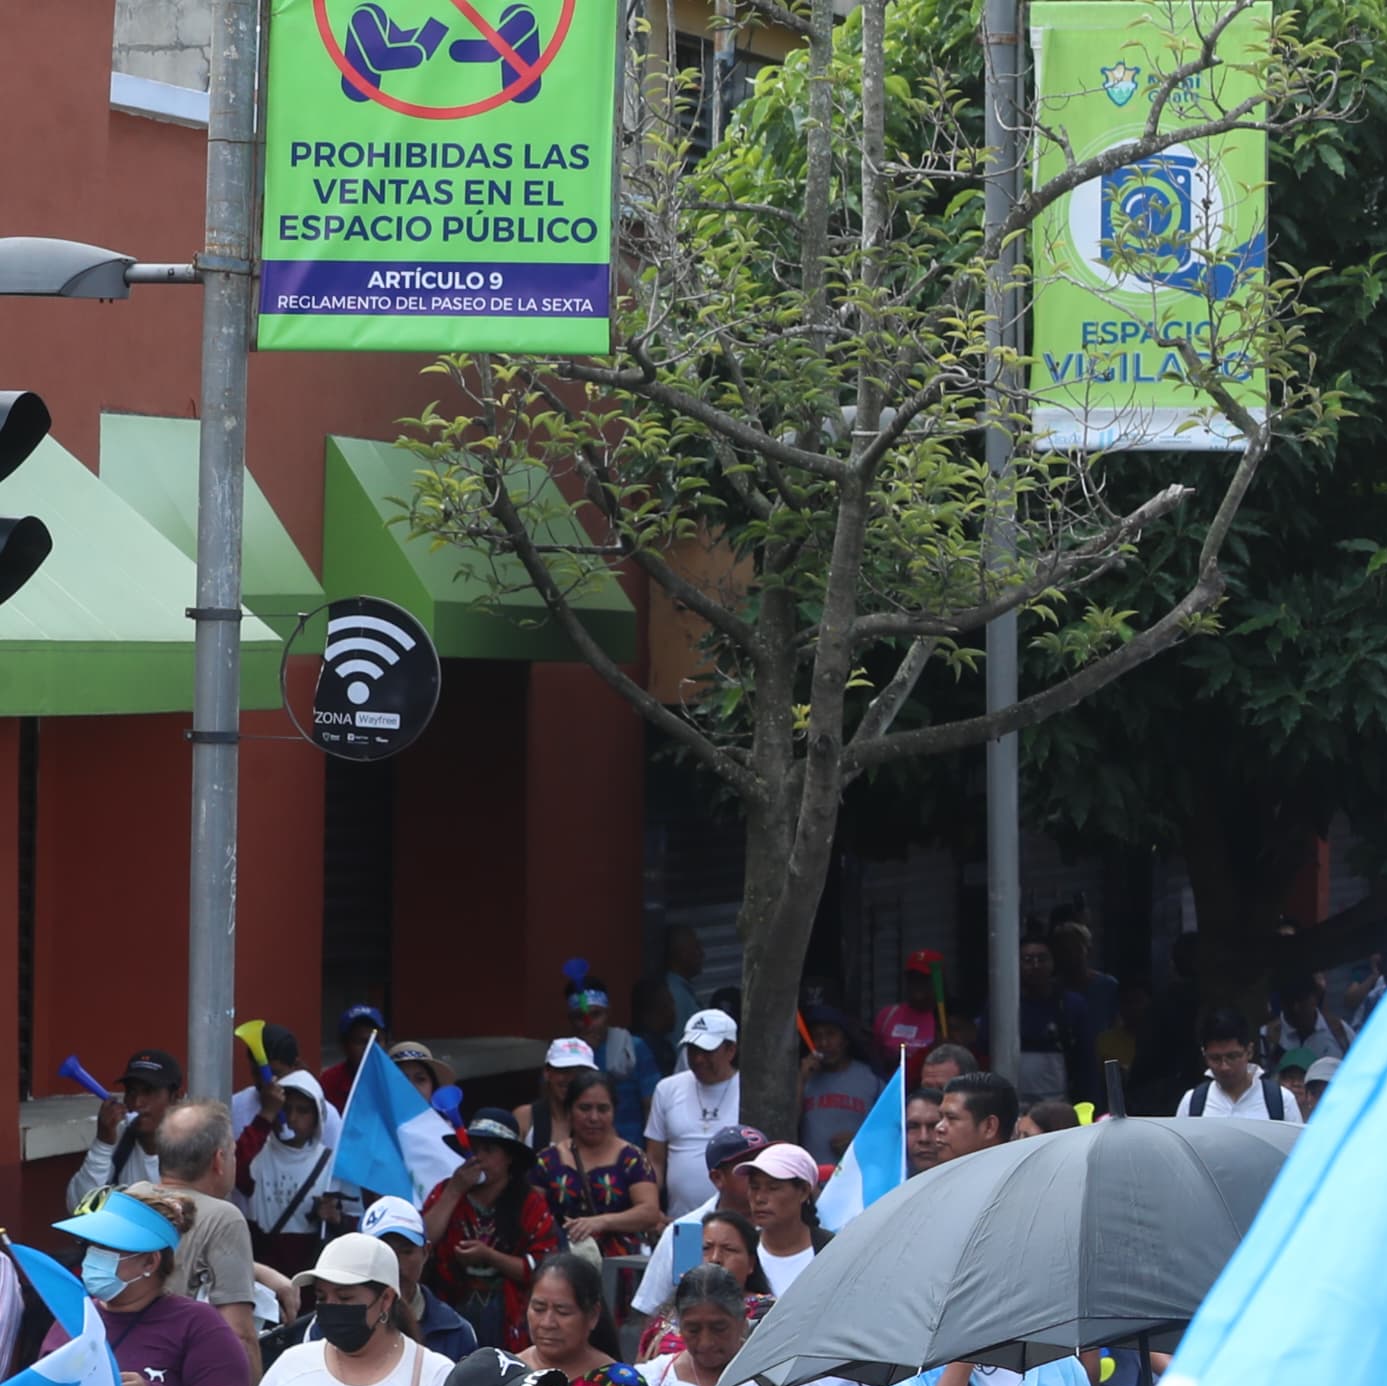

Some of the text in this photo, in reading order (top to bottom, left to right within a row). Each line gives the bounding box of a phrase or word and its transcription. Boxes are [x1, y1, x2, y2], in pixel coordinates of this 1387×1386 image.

[290, 141, 590, 170] PROHIBIDAS LAS
[313, 178, 564, 206] VENTAS EN EL
[279, 209, 597, 243] ESPACIO PÚBLICO
[367, 267, 503, 290] ARTÍCULO 9
[277, 295, 593, 313] REGLAMENTO DEL PASEO DE LA SEXTA
[314, 711, 353, 725] ZONA
